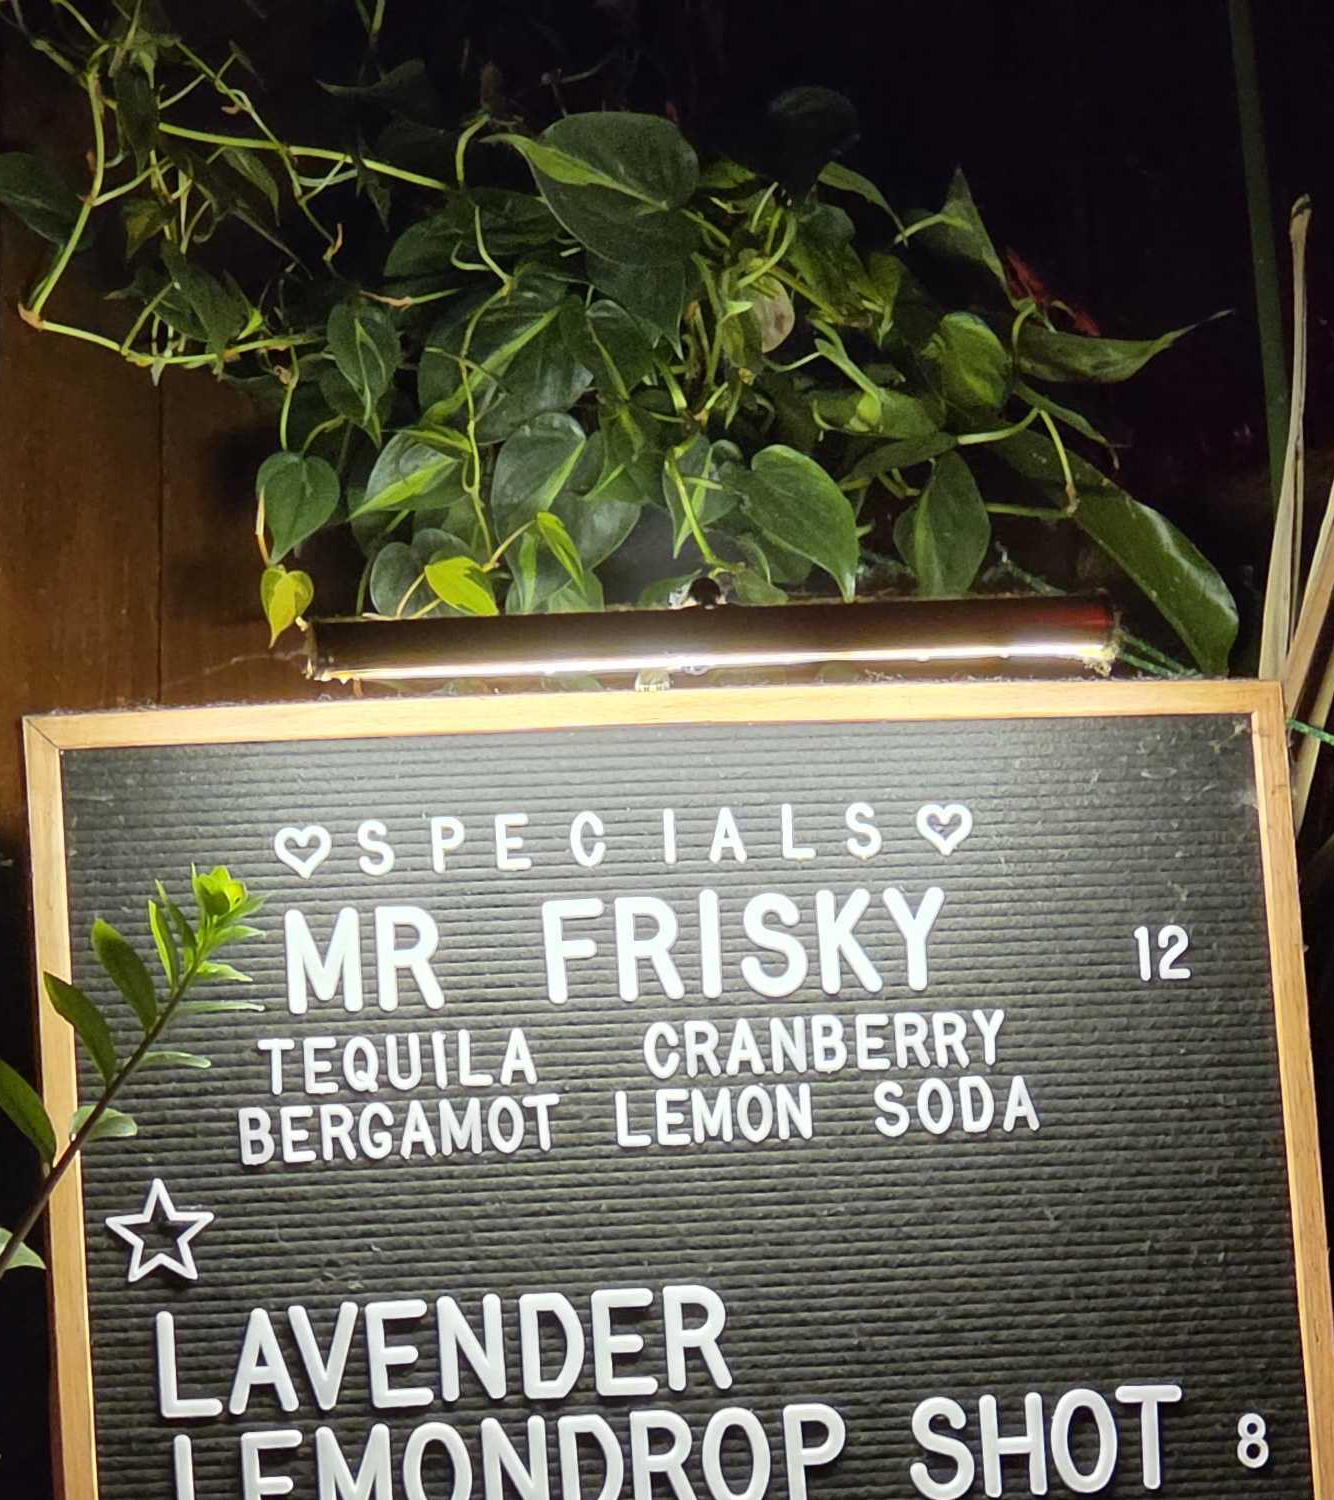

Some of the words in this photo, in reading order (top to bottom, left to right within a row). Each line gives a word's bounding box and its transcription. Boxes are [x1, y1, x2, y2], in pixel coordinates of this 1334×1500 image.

[358, 801, 883, 875] SPECIALS
[284, 905, 444, 1015] MR
[542, 886, 946, 1006] FRISKY
[1134, 925, 1190, 981] 12
[257, 1026, 537, 1096] TEQUILA
[643, 1008, 1006, 1080] CRANBERRY
[238, 1091, 559, 1167] BERGAMOT
[614, 1082, 814, 1148] LEMON
[873, 1075, 1040, 1138] SODA
[156, 1284, 733, 1418] LAVENDER
[910, 1385, 1182, 1500] SHOT
[1237, 1413, 1268, 1468] 8
